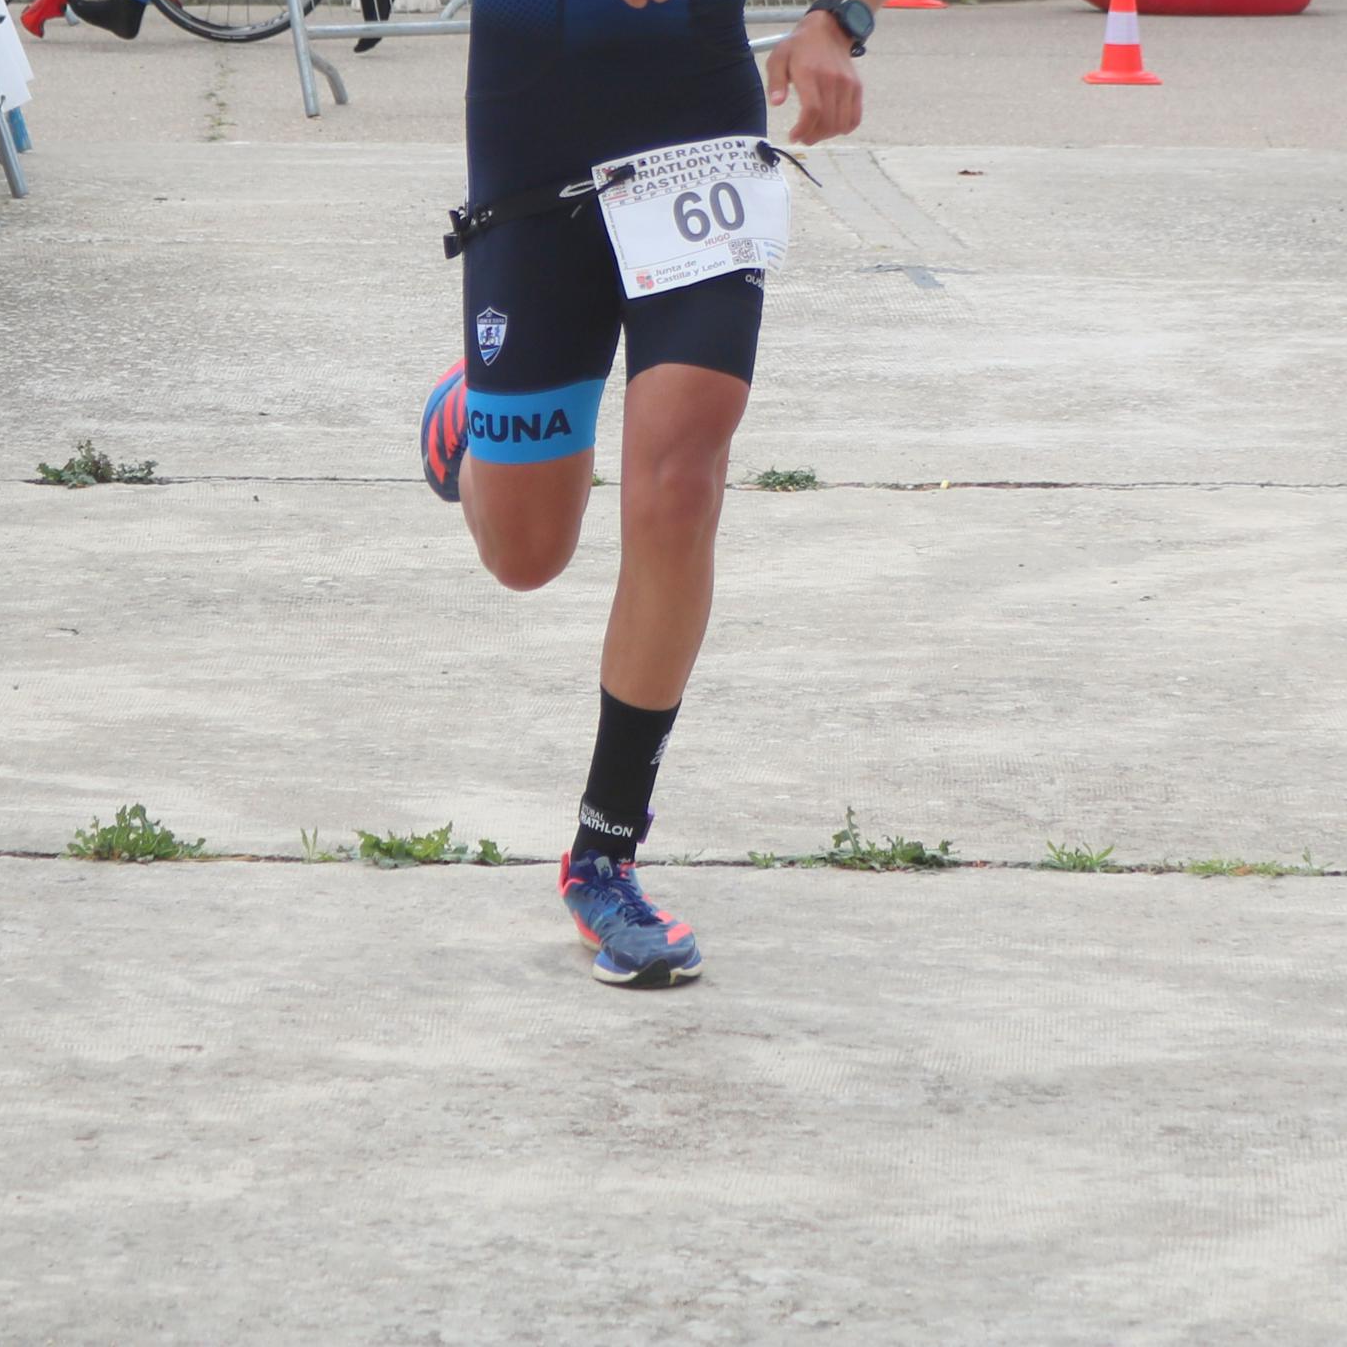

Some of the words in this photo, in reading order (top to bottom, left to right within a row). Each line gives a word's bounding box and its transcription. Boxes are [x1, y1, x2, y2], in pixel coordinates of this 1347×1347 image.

[714, 153, 724, 163] Y
[632, 166, 720, 195] CASTILLA
[726, 163, 736, 172] Y
[673, 181, 745, 243] 60
[704, 232, 731, 247] HUGO
[655, 264, 682, 277] Junta
[684, 260, 697, 268] de
[656, 271, 691, 285] Castilla
[691, 268, 700, 277] y
[702, 259, 727, 272] León
[467, 408, 572, 443] GUNA
